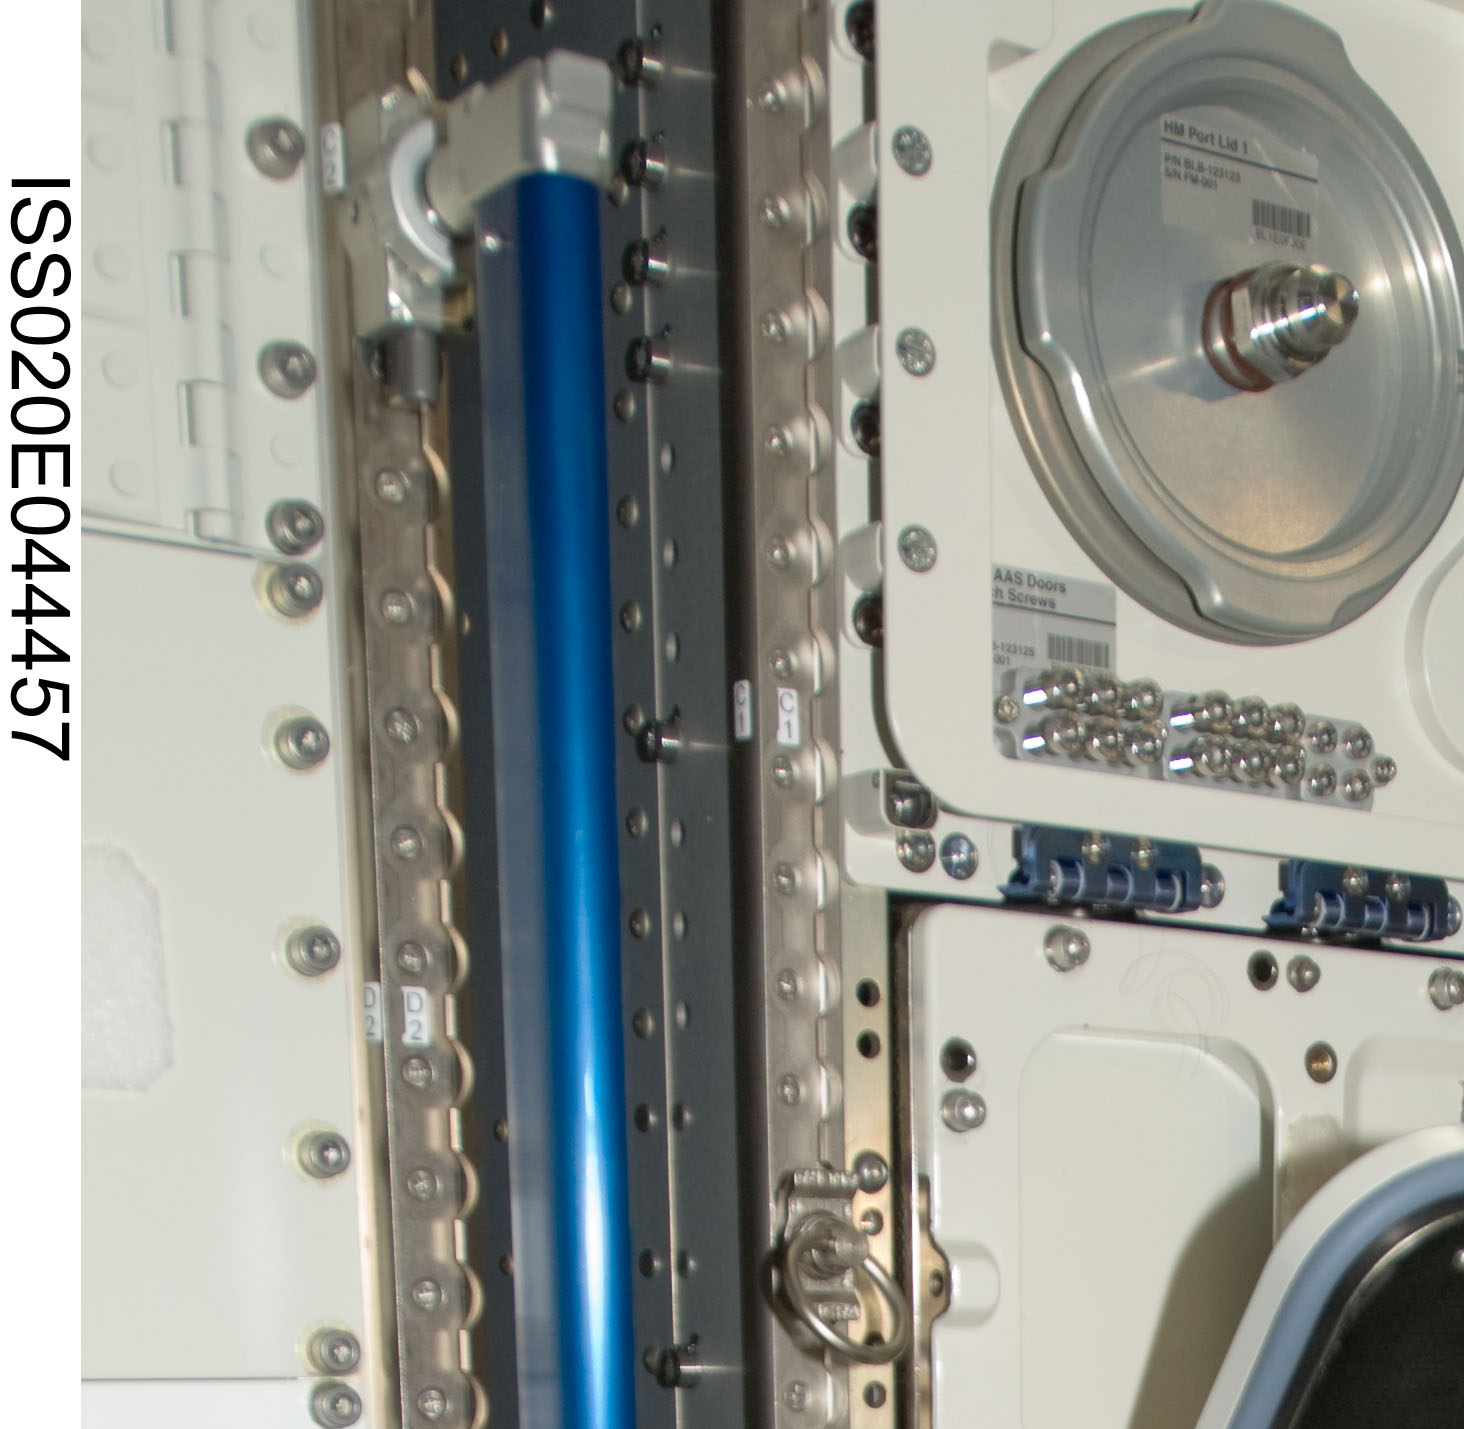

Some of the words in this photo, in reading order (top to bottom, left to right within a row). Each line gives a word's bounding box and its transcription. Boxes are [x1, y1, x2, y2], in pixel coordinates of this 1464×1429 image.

[1164, 119, 1185, 136] HM
[1189, 126, 1215, 145] Port
[1218, 134, 1238, 151] Lid
[993, 567, 1023, 585] AAS
[1027, 573, 1067, 593] Doors
[1008, 587, 1056, 609] Screws
